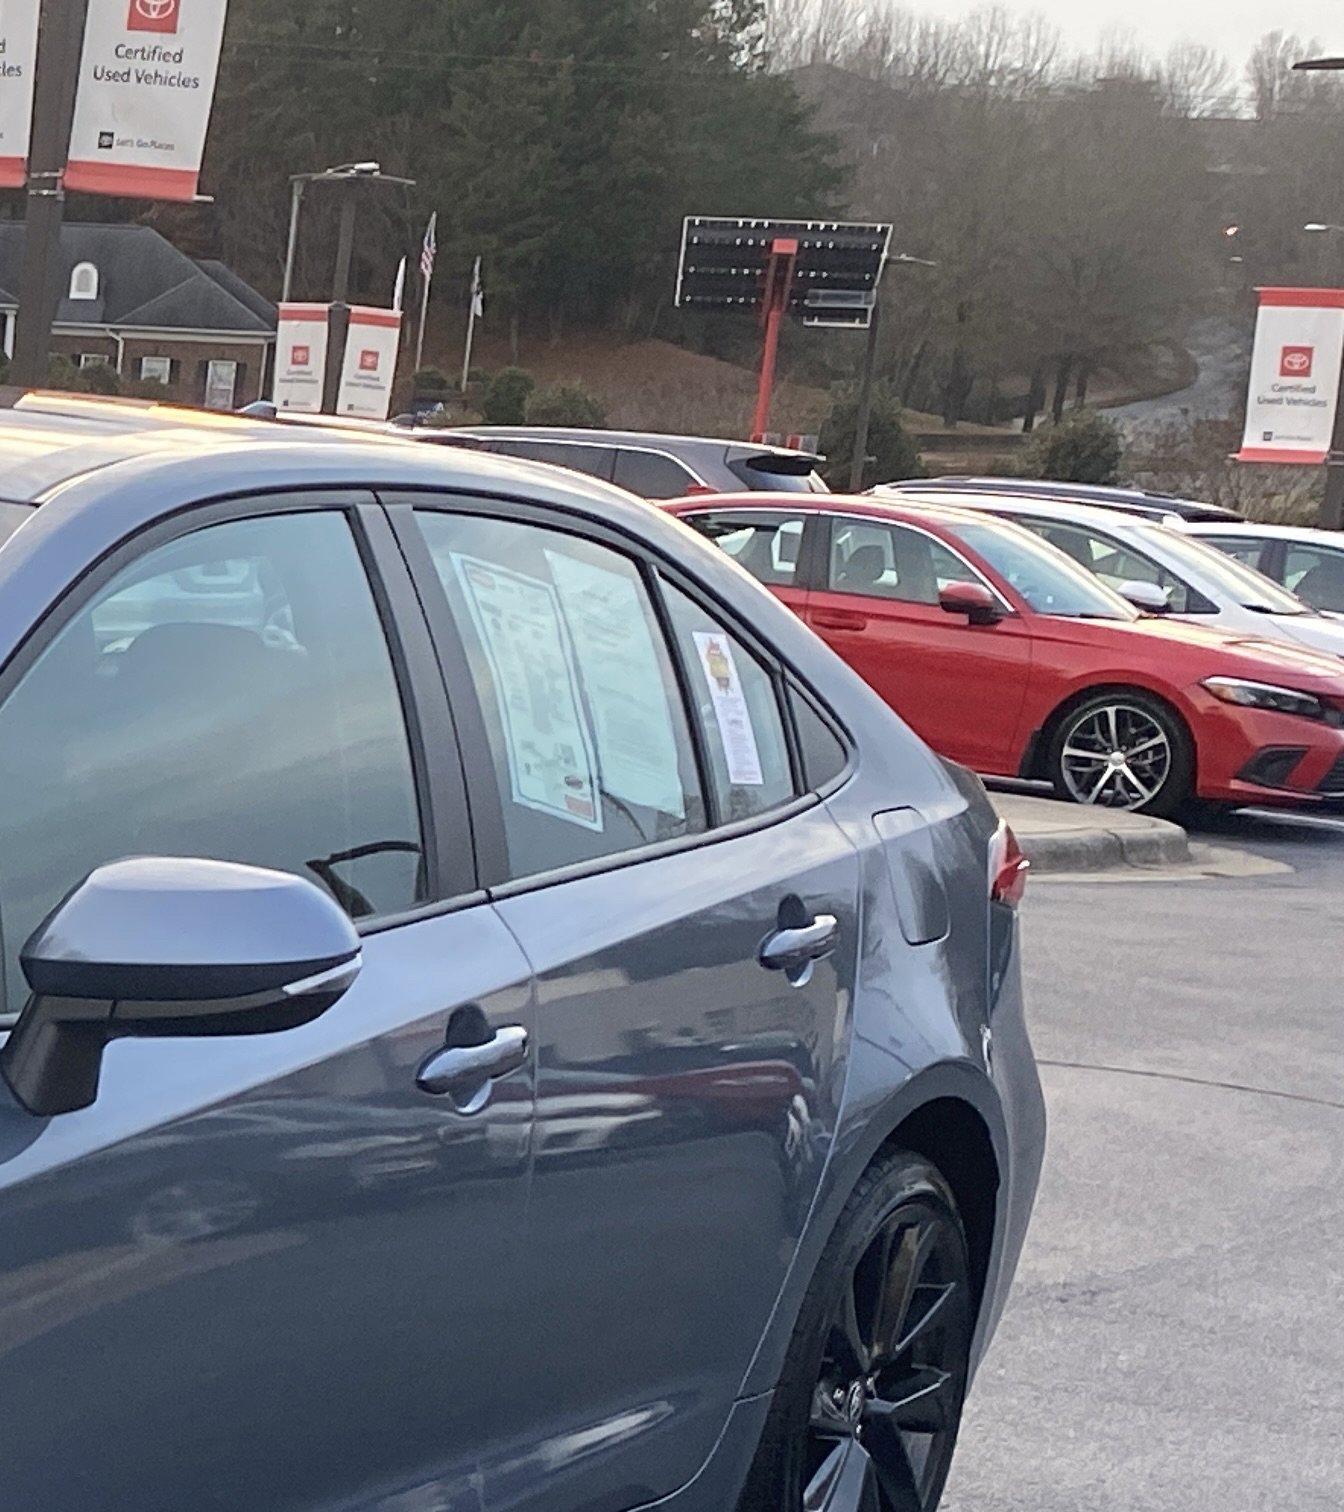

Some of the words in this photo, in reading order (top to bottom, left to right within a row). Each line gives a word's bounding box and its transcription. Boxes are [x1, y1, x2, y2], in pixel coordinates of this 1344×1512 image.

[114, 43, 184, 64] Certified
[93, 64, 131, 83] Used
[134, 68, 200, 89] Vehicles
